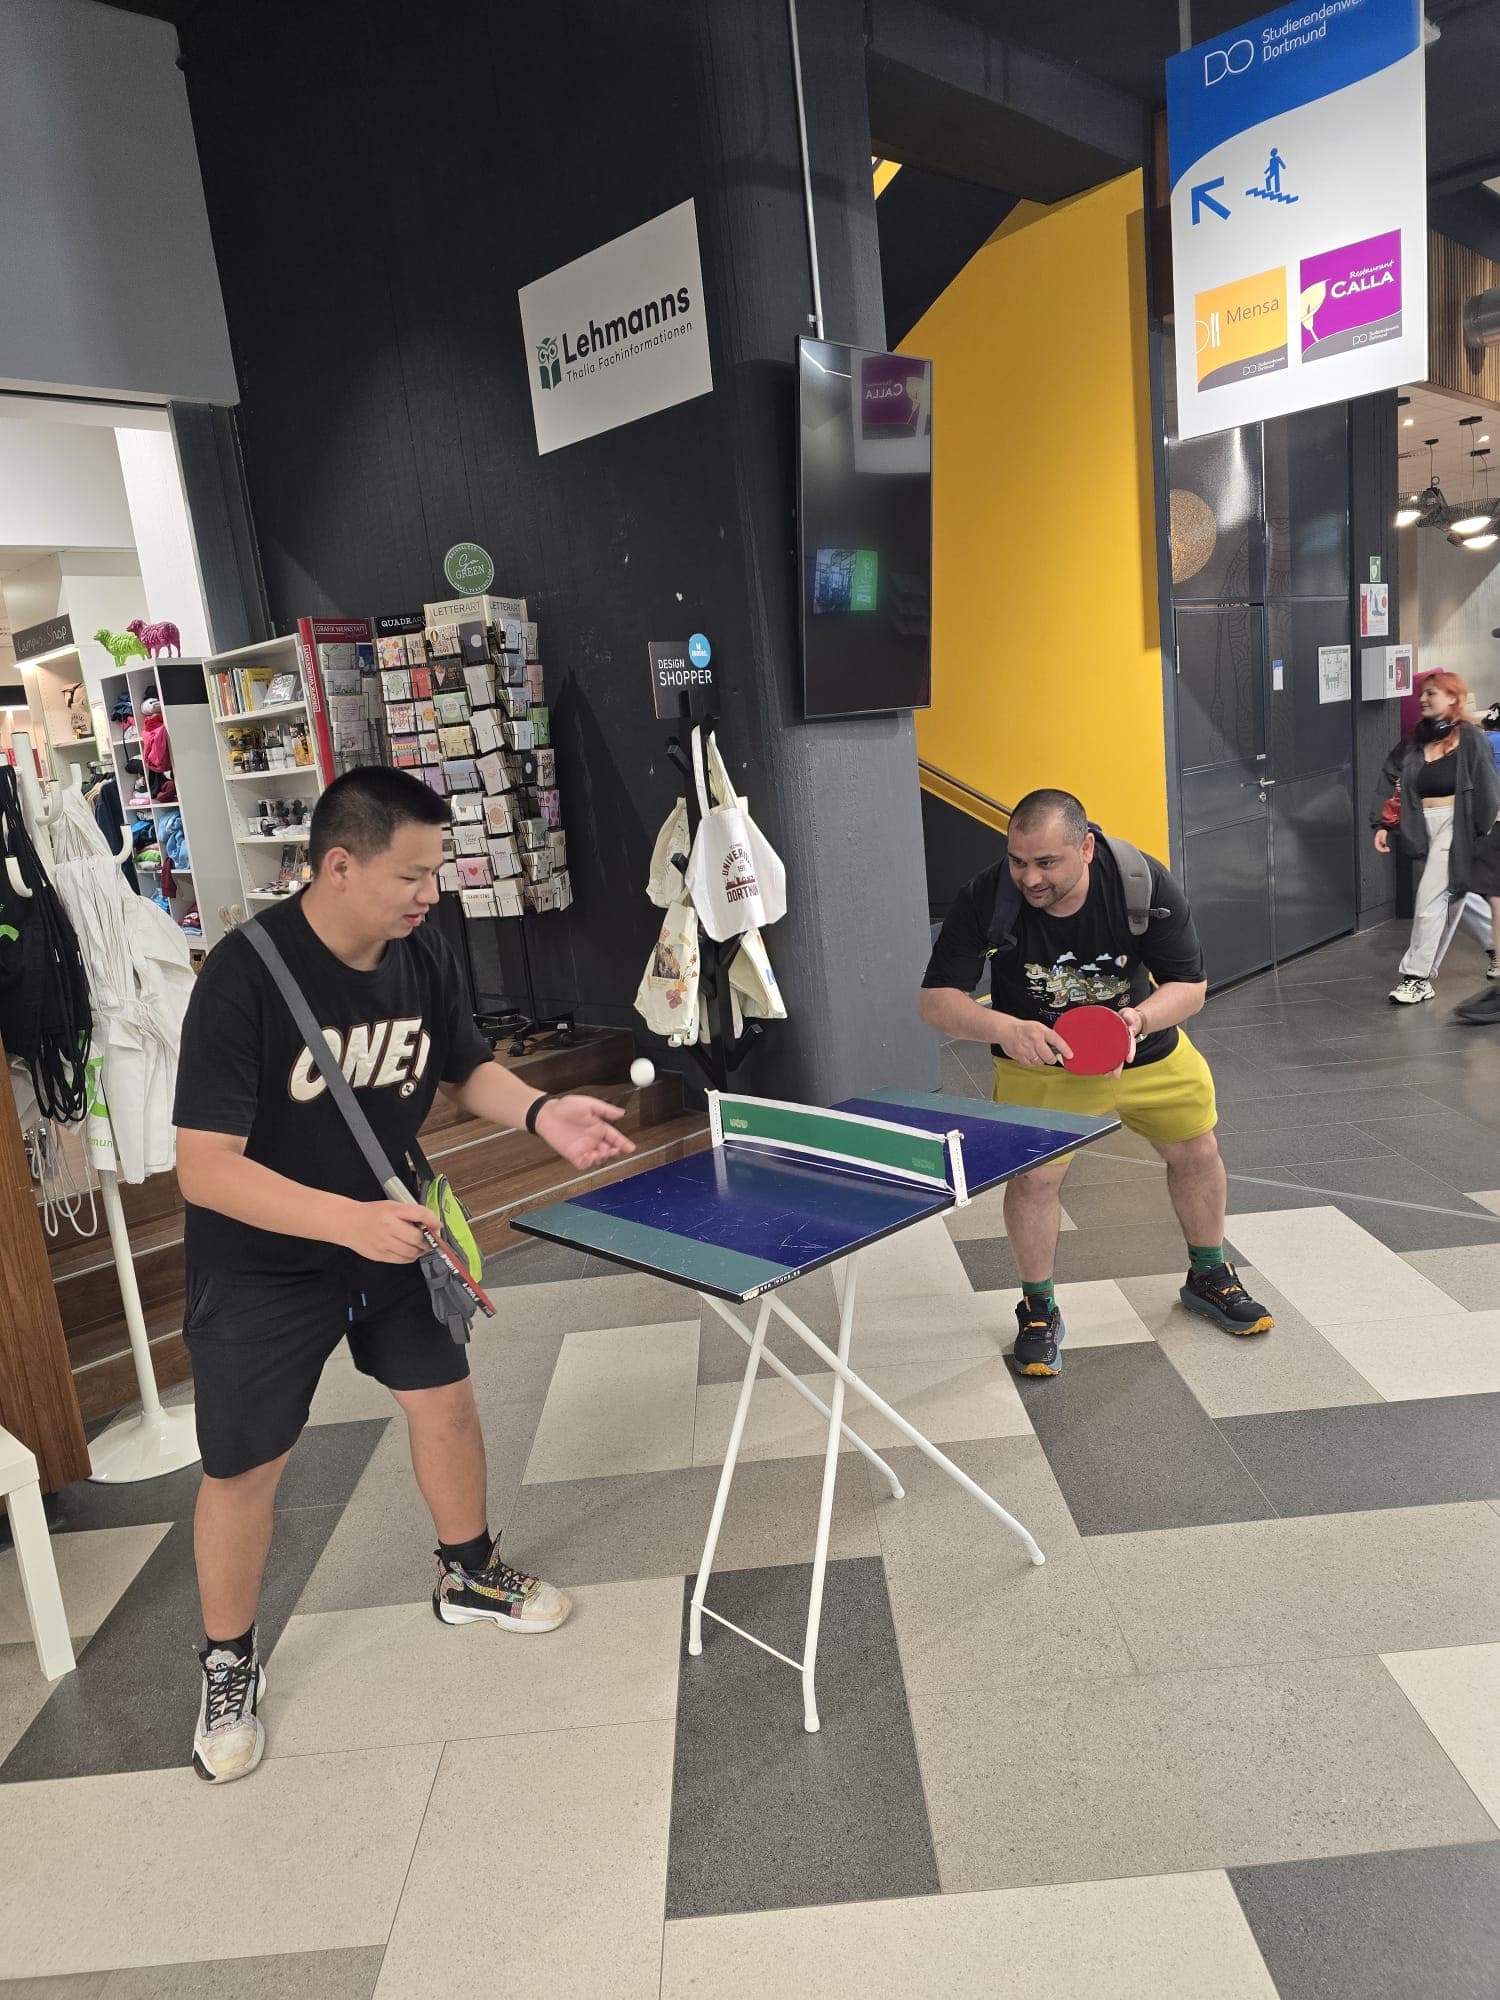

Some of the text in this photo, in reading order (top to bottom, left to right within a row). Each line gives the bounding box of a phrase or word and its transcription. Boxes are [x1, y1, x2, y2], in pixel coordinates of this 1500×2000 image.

[1262, 0, 1364, 44] Studierendenwe
[1263, 20, 1327, 62] Dortmund
[1204, 39, 1254, 87] DO
[1349, 259, 1396, 279] Restaurant
[1331, 270, 1395, 298] CALLA
[1226, 298, 1280, 325] Mensa
[562, 286, 690, 365] Lehmanns
[1352, 333, 1367, 345] DO
[566, 321, 693, 383] Thalia Fachinformationen
[1242, 364, 1256, 376] DO
[455, 564, 486, 580] GREEN
[432, 601, 481, 617] LETTERART
[657, 658, 685, 669] DESIGN
[659, 669, 712, 686] SHOPPER
